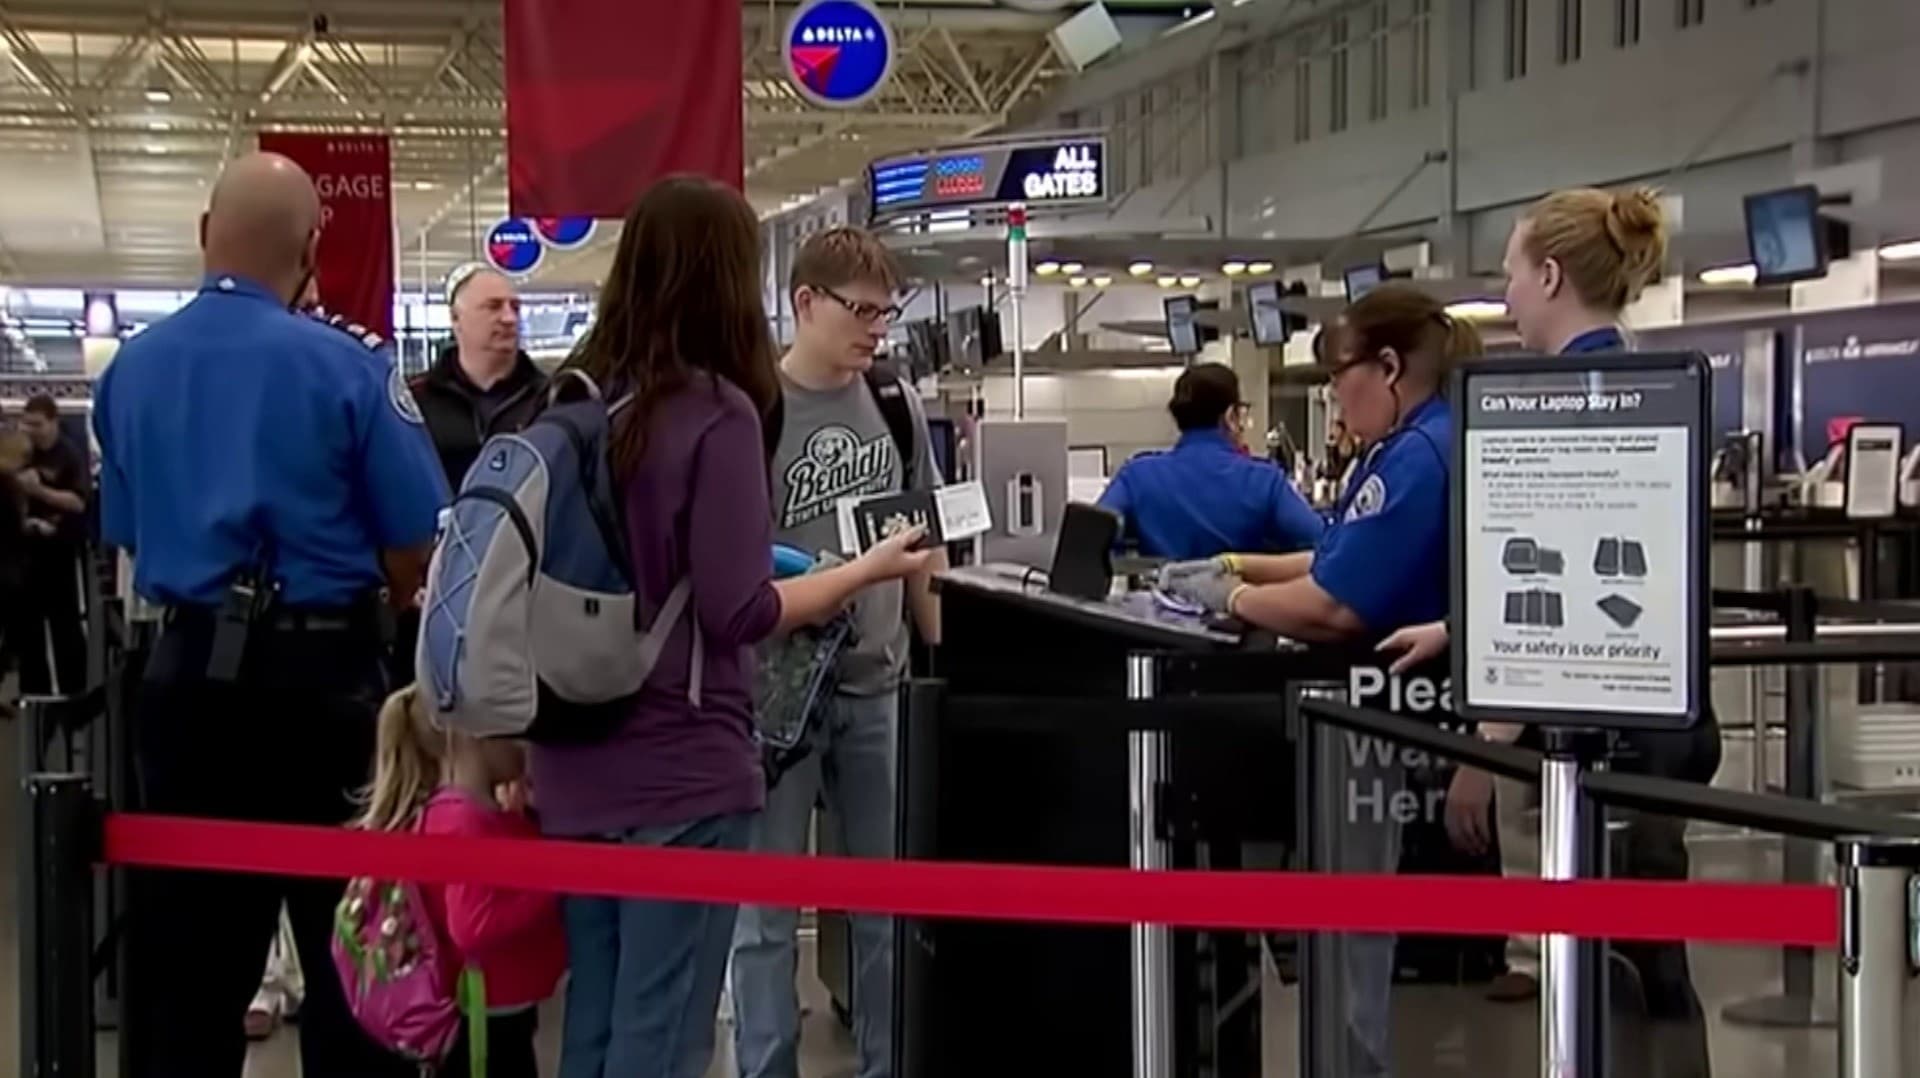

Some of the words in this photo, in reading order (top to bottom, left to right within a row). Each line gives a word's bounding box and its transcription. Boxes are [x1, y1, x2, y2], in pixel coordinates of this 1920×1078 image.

[816, 26, 863, 42] DELTA
[1054, 146, 1097, 170] ALL
[316, 174, 384, 198] GAGE
[1024, 170, 1097, 198] GATES
[1481, 396, 1506, 411] Can
[1506, 395, 1537, 411] Your
[1540, 395, 1586, 412] Laptop
[1493, 640, 1522, 654] Your
[1525, 640, 1565, 657] safety
[1568, 643, 1580, 655] is
[1582, 644, 1605, 656] our
[1608, 643, 1661, 660] priority
[1348, 779, 1446, 824] Her
